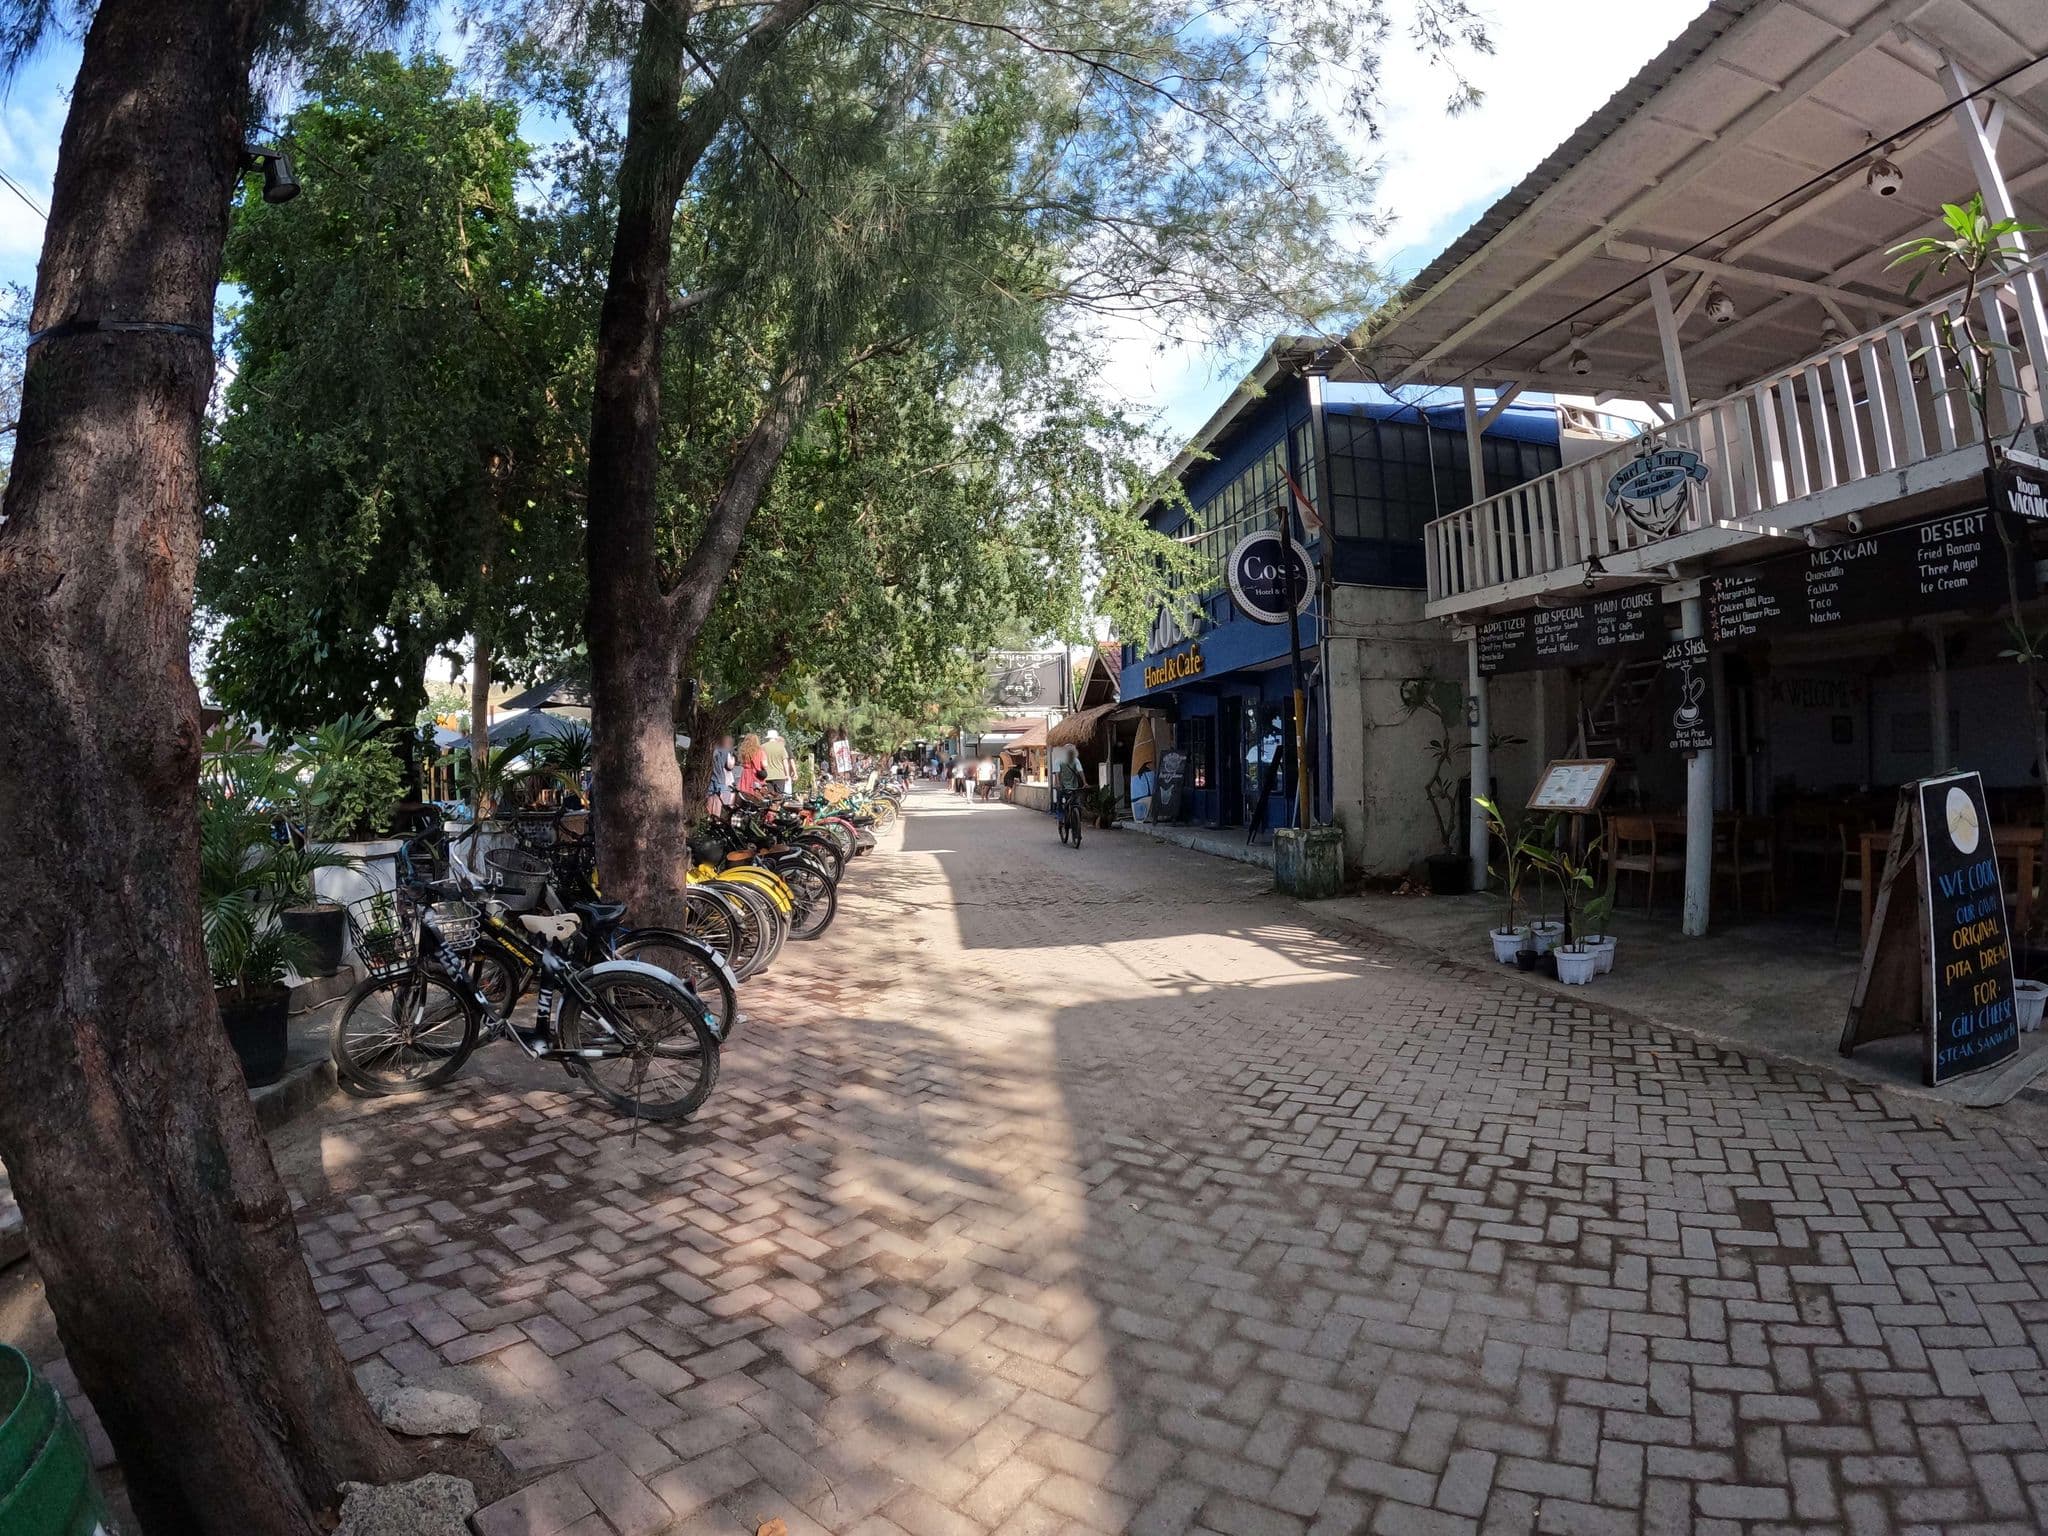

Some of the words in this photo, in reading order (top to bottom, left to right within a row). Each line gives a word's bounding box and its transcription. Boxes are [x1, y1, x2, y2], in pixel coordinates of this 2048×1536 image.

[1657, 453, 1684, 466] Turf
[2016, 475, 2041, 496] Room
[1921, 513, 1987, 543] DESERT
[1811, 540, 1878, 567] MEXICAN
[1917, 549, 1943, 561] Fried
[1946, 542, 1981, 555] Banana
[1918, 563, 1949, 577] Three
[1953, 556, 1978, 572] Angel
[1724, 576, 1757, 588] PIZ
[1920, 582, 1934, 594] Ice
[1938, 577, 1969, 590] Cream
[1594, 600, 1618, 615] MAIN
[1621, 592, 1654, 610] COURSE
[1809, 599, 1832, 610] Taco
[1484, 616, 1526, 634] APPETIZER
[1534, 612, 1550, 625] OUR
[1551, 606, 1585, 621] SPECIAL
[1810, 611, 1841, 624] Nachos
[1721, 627, 1737, 639] Beef
[1676, 730, 1690, 739] Best
[1691, 728, 1705, 737] Price
[1938, 868, 1966, 899] WE
[1968, 858, 1997, 891] COOK
[1955, 904, 1976, 925] OUR
[1952, 917, 2000, 950] ORIGINAL
[1945, 960, 1973, 986] PITA
[1973, 978, 1998, 1006] FOR
[1978, 997, 2012, 1030] CHEESE
[1937, 1040, 1976, 1065] STEAK
